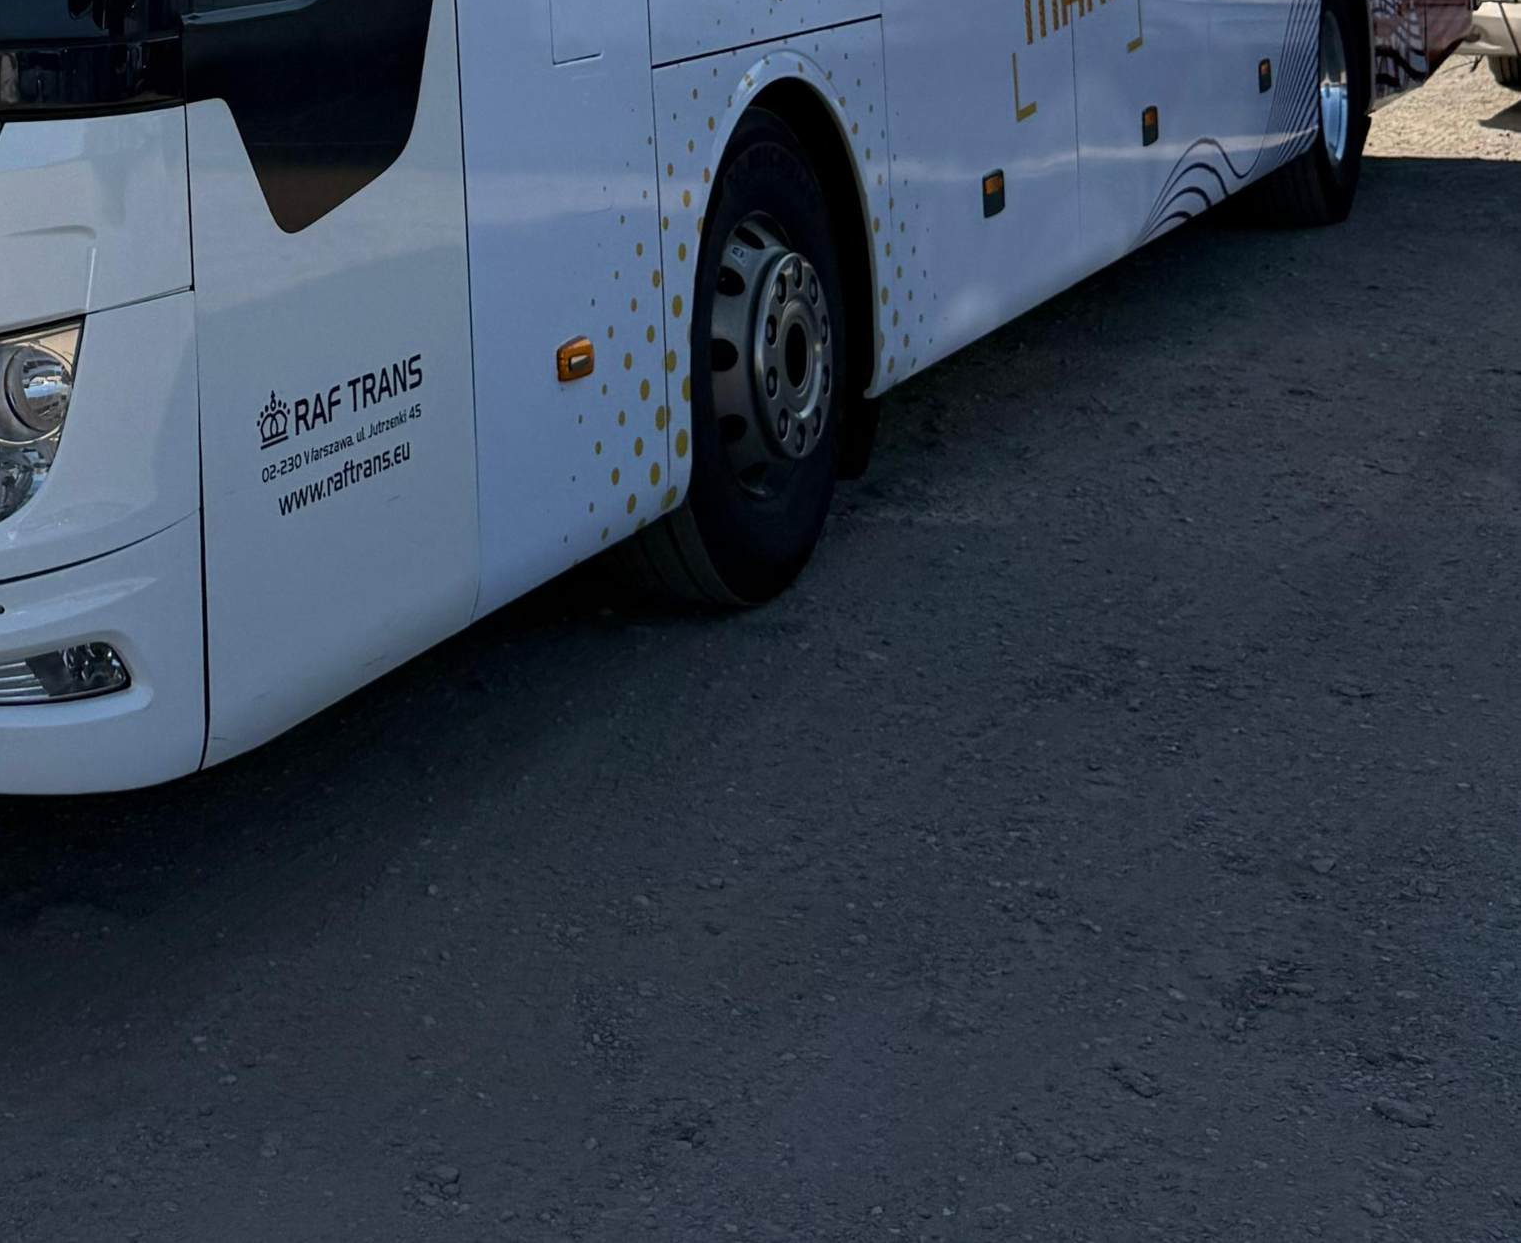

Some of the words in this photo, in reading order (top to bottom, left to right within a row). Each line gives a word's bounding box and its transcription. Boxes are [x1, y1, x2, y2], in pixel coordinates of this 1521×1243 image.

[294, 384, 342, 437] RAF
[347, 353, 423, 413] TRANS
[261, 453, 302, 483] 02-230
[408, 403, 422, 420] 45
[278, 441, 411, 516] www.raftrans.eu
